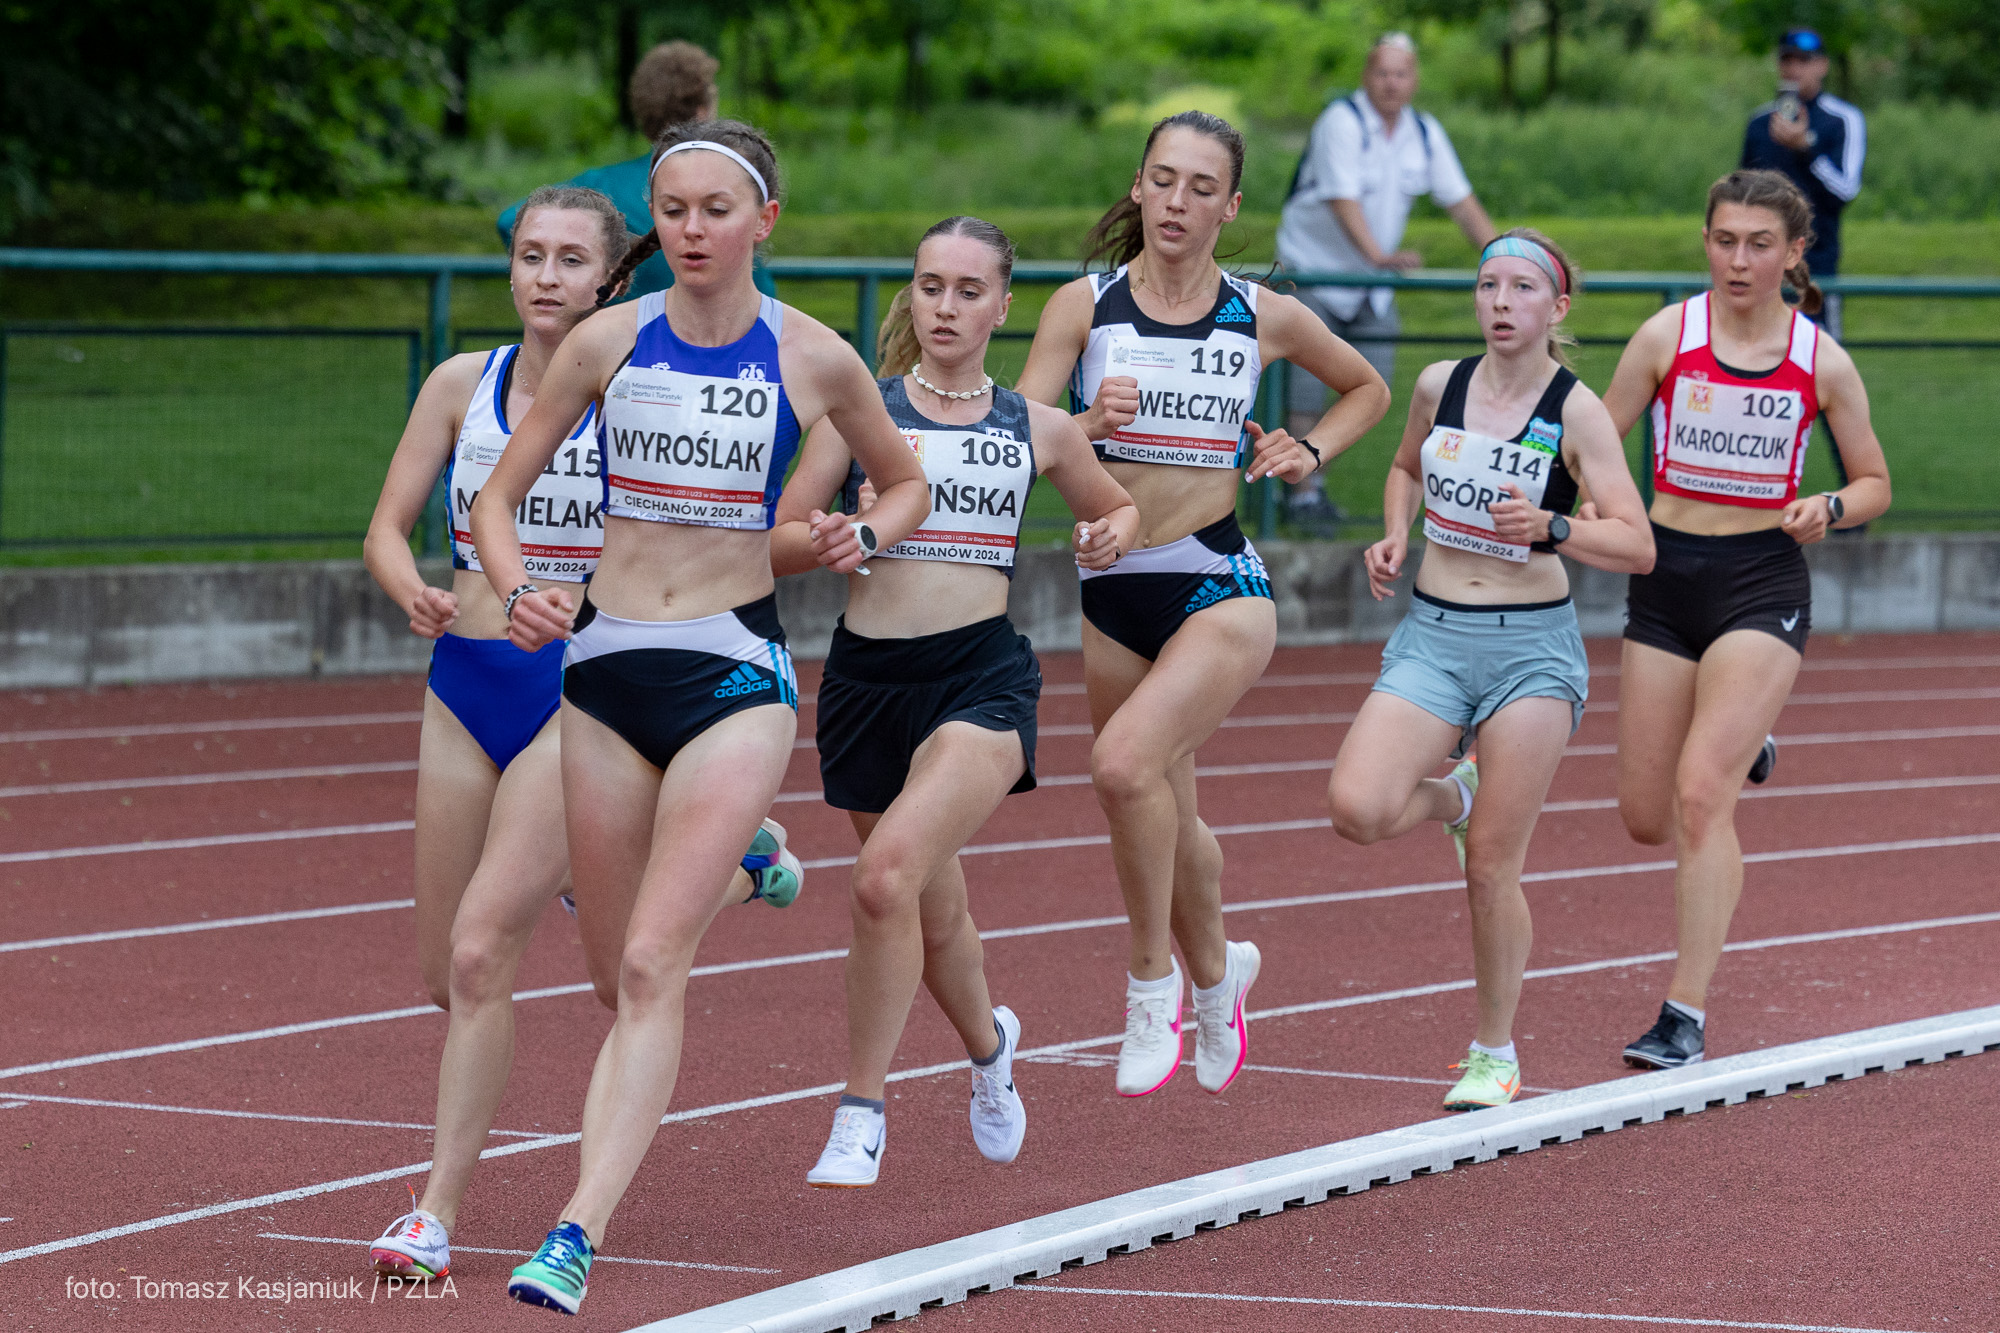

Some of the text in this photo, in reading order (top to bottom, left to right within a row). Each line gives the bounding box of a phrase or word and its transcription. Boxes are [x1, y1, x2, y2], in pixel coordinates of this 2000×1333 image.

[1215, 312, 1252, 323] adidas
[1190, 347, 1245, 377] 119
[631, 390, 651, 399] Sportu
[656, 392, 683, 401] Turystyki
[632, 382, 671, 392] Ministerstwo
[700, 384, 768, 418] 120
[1134, 390, 1244, 425] WEŁCZYK
[1743, 393, 1792, 420] 102
[612, 427, 766, 472] WYROŚLAK
[1675, 424, 1788, 460] KAROLCZUK
[961, 438, 1022, 468] 108
[1118, 446, 1224, 464] CIECHANÓW 2024
[1488, 446, 1542, 481] 114
[656, 487, 673, 495] Polski
[710, 493, 727, 501] Biegu
[1428, 472, 1513, 514] OGÓR
[1676, 475, 1773, 495] CIECHANÓW 2024
[624, 495, 743, 518] CIECHANÓW 2024
[974, 536, 987, 544] Biegu
[1485, 544, 1514, 557] 2024
[886, 545, 1000, 561] CIECHANÓW 2024
[554, 562, 588, 572] 2024
[1185, 586, 1232, 613] adidas
[714, 680, 772, 698] adidas
